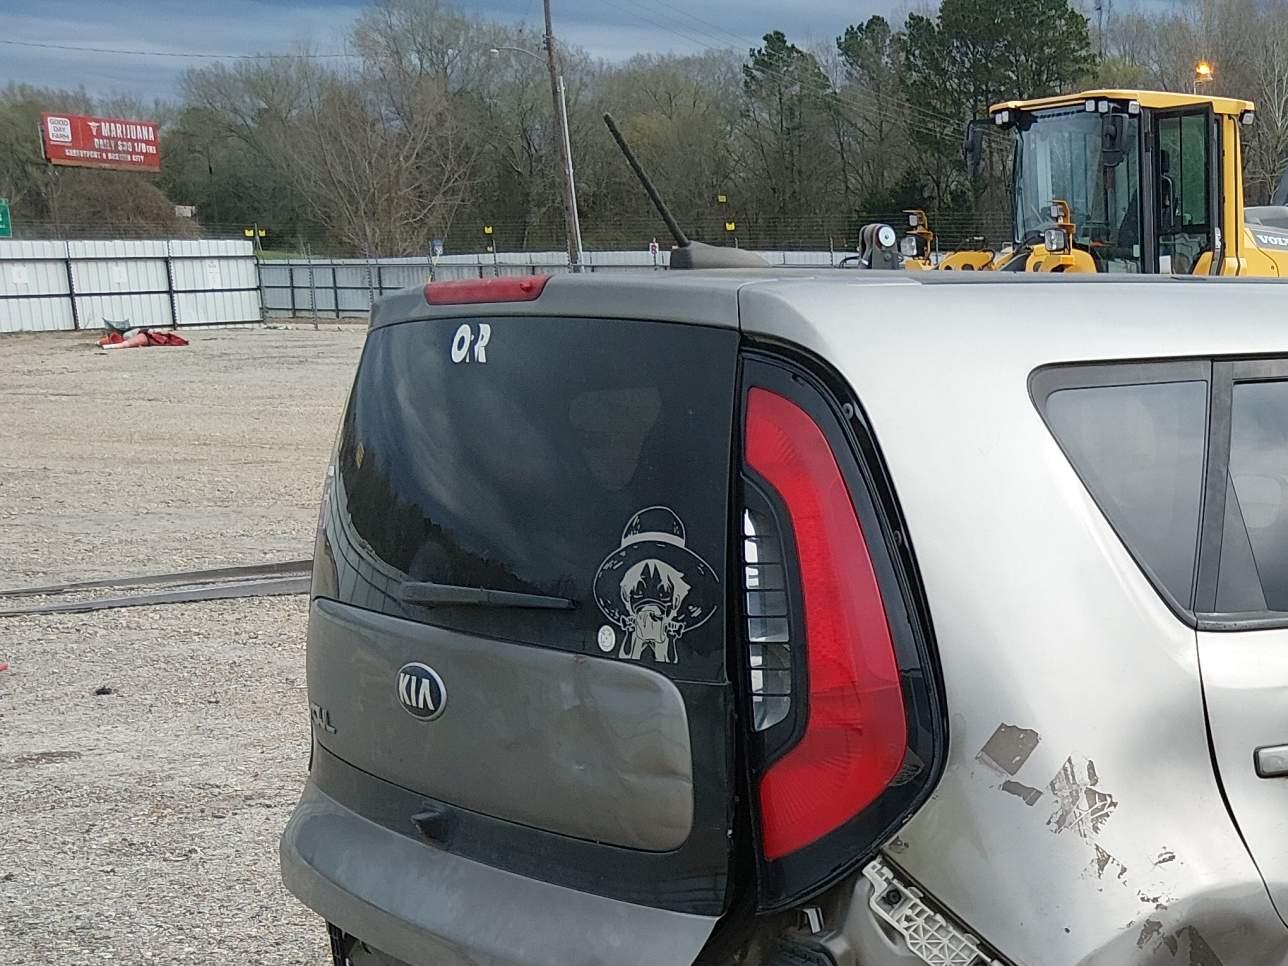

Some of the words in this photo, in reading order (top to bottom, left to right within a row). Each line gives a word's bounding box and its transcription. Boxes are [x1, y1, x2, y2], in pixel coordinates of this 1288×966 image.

[101, 122, 155, 142] MARIJUANA
[399, 672, 435, 711] KIA
[311, 701, 337, 735] OUL
